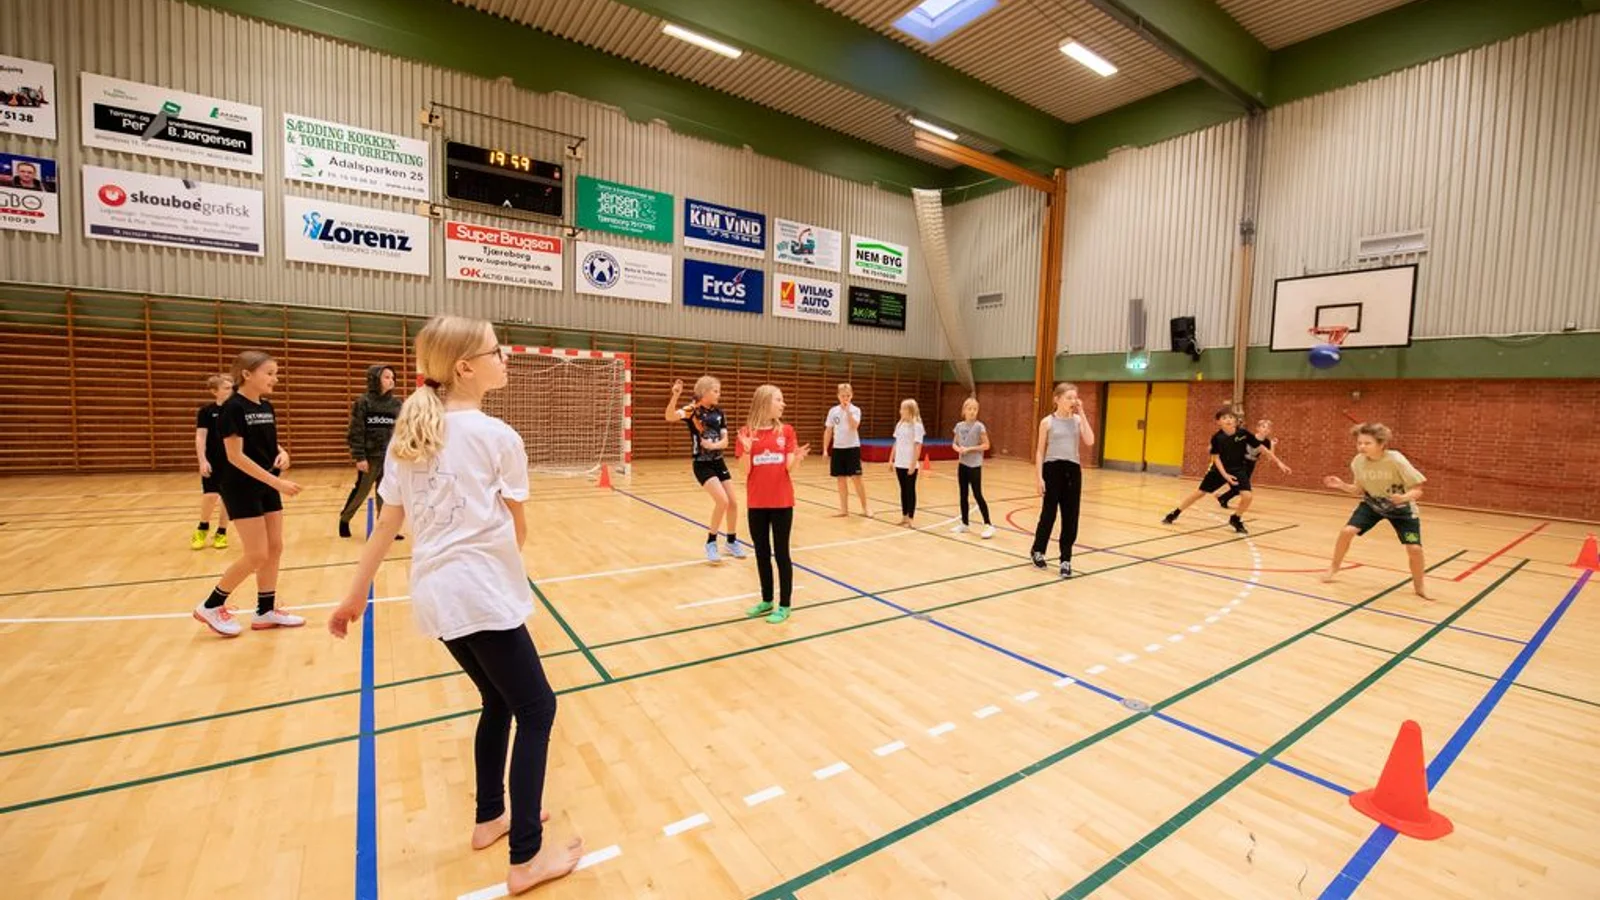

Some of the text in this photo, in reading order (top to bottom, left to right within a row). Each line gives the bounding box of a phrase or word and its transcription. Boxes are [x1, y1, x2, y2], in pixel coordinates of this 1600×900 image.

[122, 118, 247, 149] Per B. Jørgensen
[286, 118, 344, 141] SÆDDING
[287, 132, 423, 167] & TØMRERFORRETNING
[410, 171, 424, 181] 25
[319, 218, 412, 252] Lorenz
[456, 224, 554, 251] SuperBrugsen
[483, 246, 531, 261] Tjæreborg
[856, 249, 902, 267] NEM BYG
[458, 254, 552, 271] www.superbrugsen.dk
[460, 267, 481, 278] OK
[798, 283, 833, 298] WILMS
[802, 296, 830, 308] AUTO
